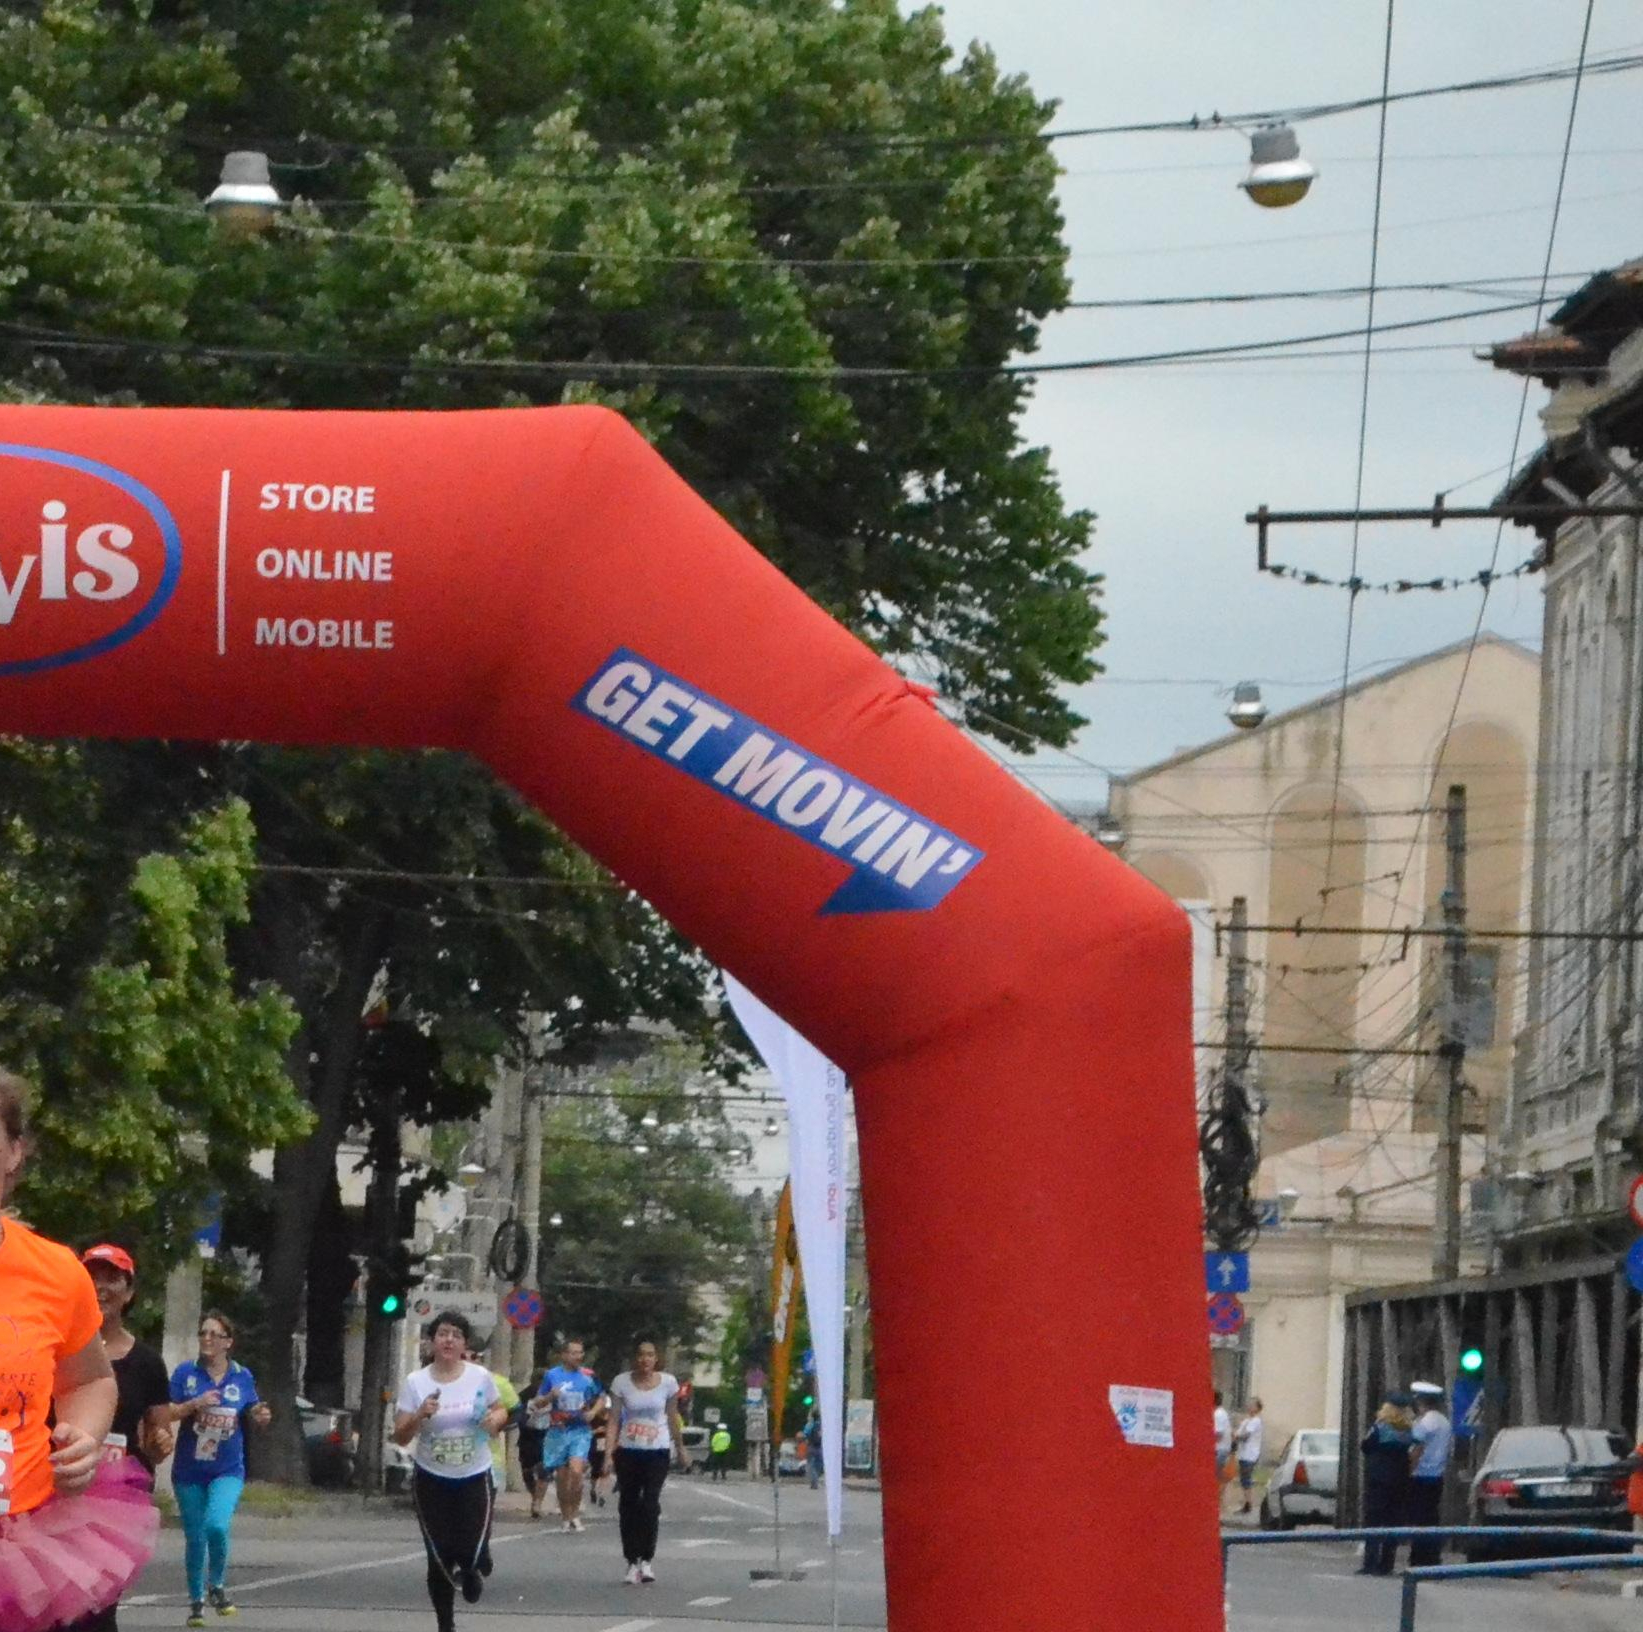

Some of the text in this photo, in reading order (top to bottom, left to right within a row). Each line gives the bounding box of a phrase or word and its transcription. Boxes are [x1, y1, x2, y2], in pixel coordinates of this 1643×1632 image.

[259, 483, 374, 513] STORE
[255, 548, 392, 582] ONLINE
[255, 618, 394, 650] MOBILE
[585, 661, 733, 761] GET
